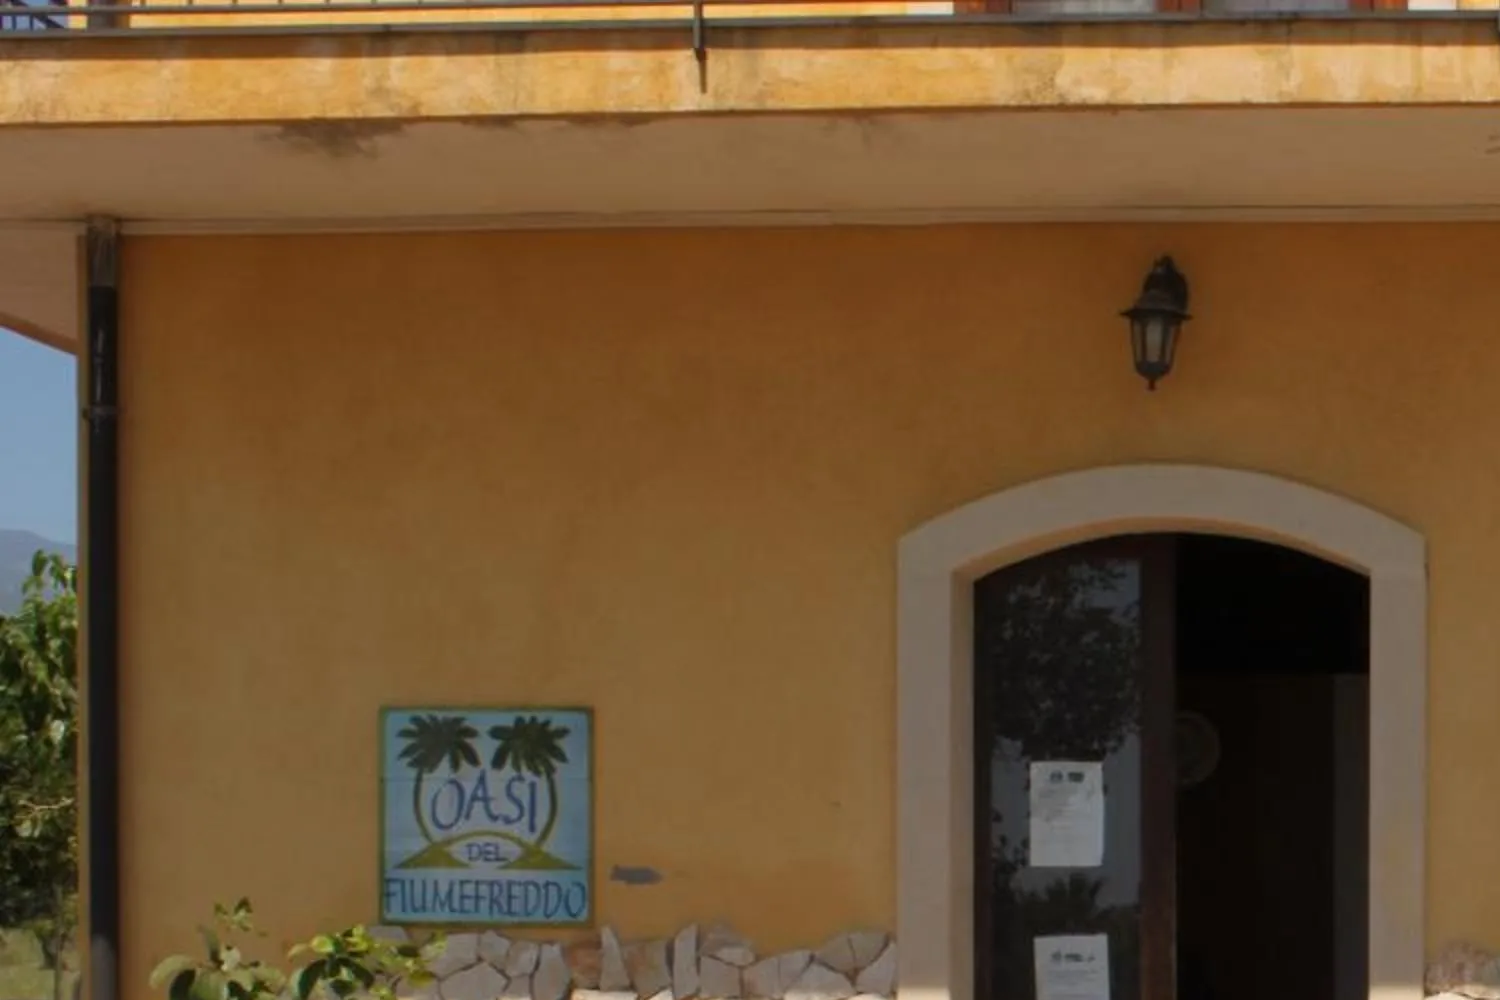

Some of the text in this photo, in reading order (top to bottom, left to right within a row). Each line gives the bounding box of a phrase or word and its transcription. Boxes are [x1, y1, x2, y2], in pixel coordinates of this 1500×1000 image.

[431, 769, 537, 833] OASI
[465, 842, 510, 862] DEL
[384, 877, 587, 919] FIUMEFREDDO
